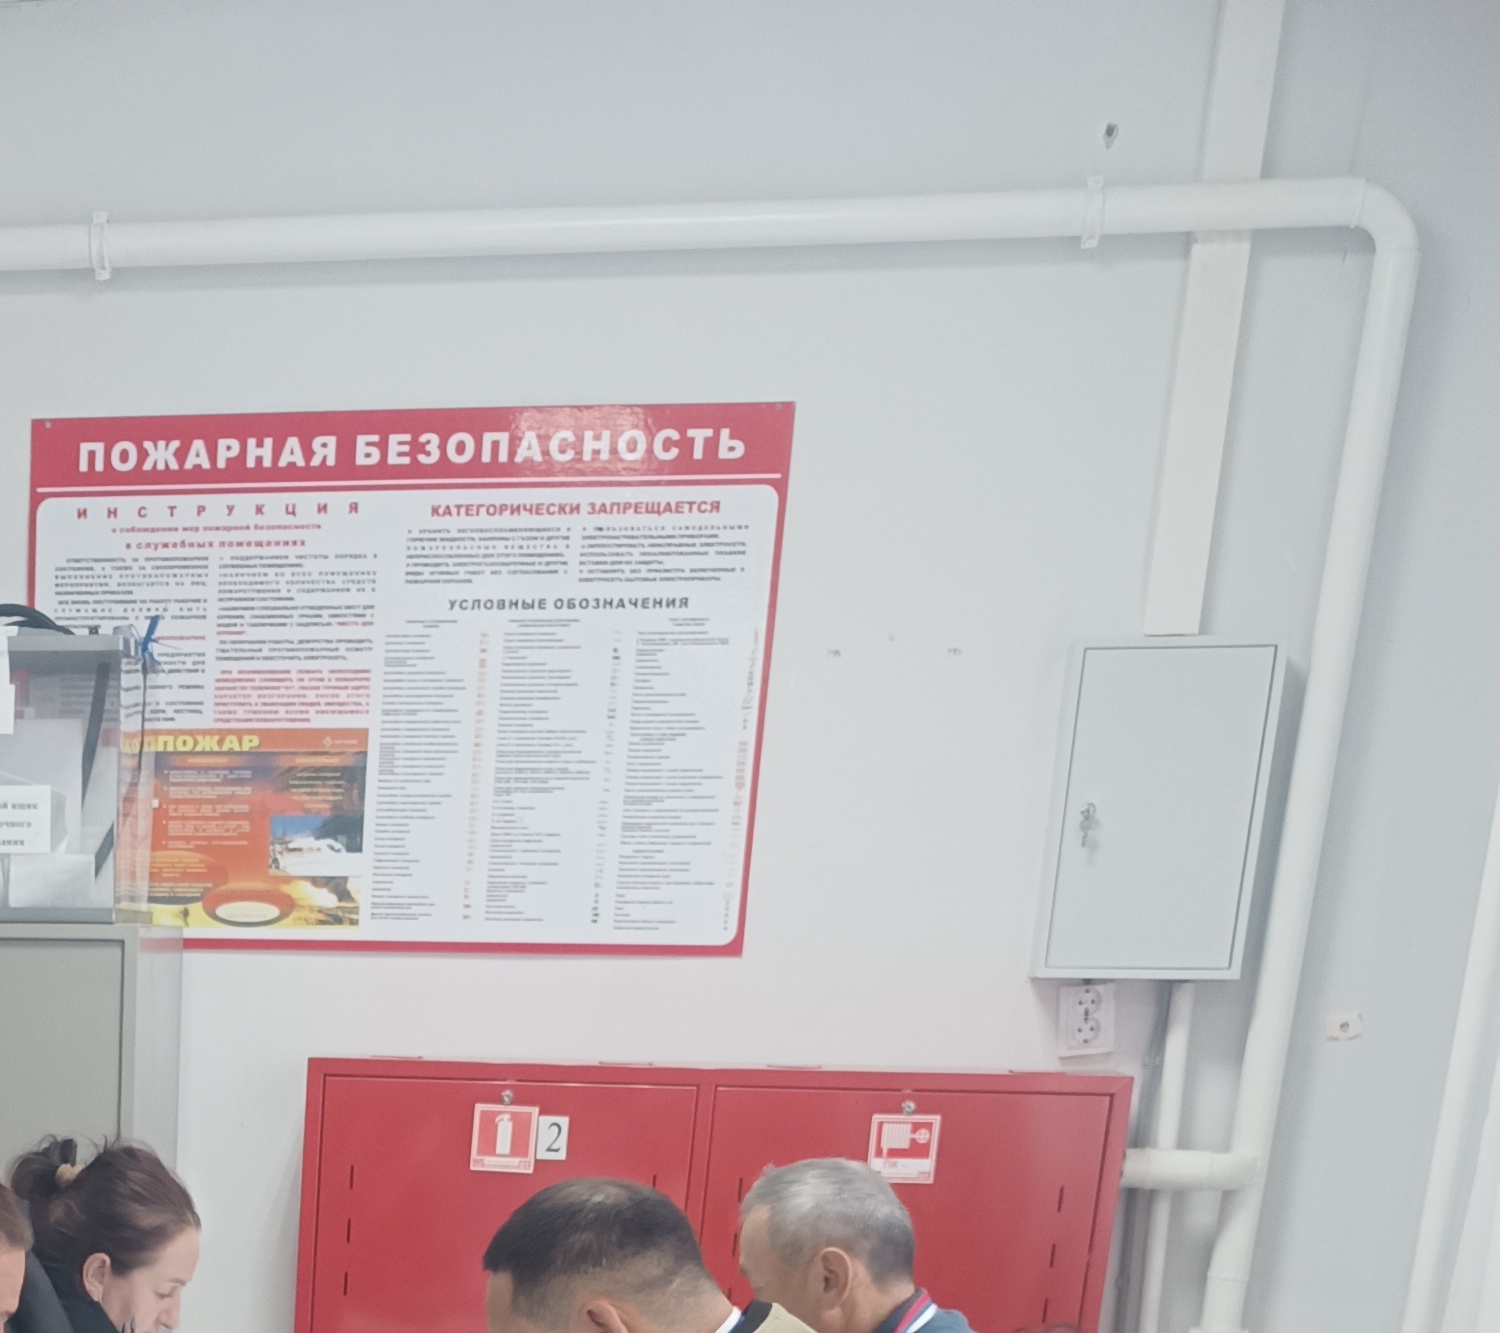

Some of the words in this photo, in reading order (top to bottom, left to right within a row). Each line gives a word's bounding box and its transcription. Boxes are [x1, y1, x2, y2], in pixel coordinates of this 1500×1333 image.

[78, 435, 338, 473] ПОЖАРНАЯ
[355, 427, 747, 466] БЕЗОПАСНОСТЬ
[430, 501, 581, 518] КАТЕГОРИЧЕСКИ
[586, 500, 721, 517] ЗАПРЕЩАЕТСЯ
[135, 538, 214, 552] служебных
[218, 537, 307, 549] помещениях
[448, 598, 547, 612] УСЛОВНЫЕ
[553, 596, 690, 611] ОБОЗНАЧЕНИЯ
[11, 801, 39, 812] ящик
[545, 1122, 562, 1153] 2
